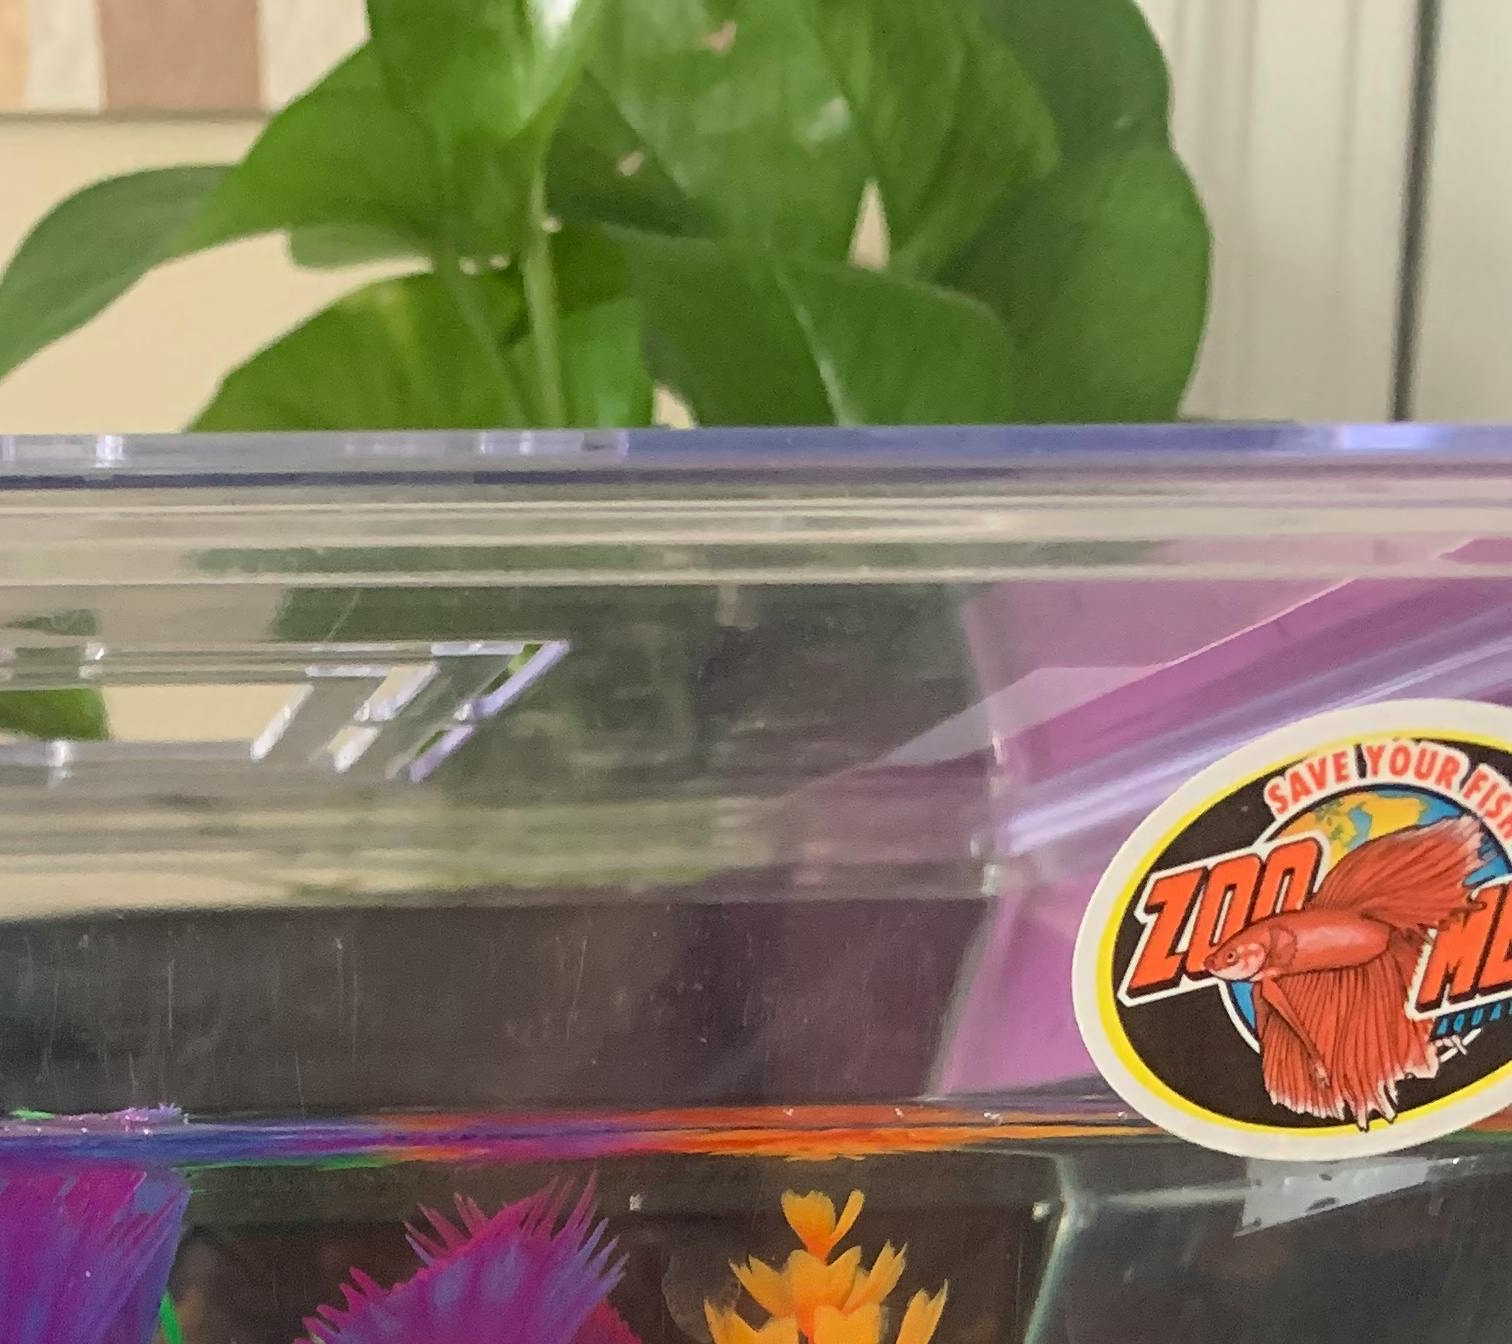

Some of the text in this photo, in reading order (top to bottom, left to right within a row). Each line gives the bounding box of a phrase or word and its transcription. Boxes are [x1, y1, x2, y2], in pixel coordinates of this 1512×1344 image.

[1267, 751, 1352, 815] SAVE
[1365, 741, 1461, 790] YOUR
[1127, 838, 1322, 996] ZOO
[1436, 1000, 1512, 1035] AQUA
